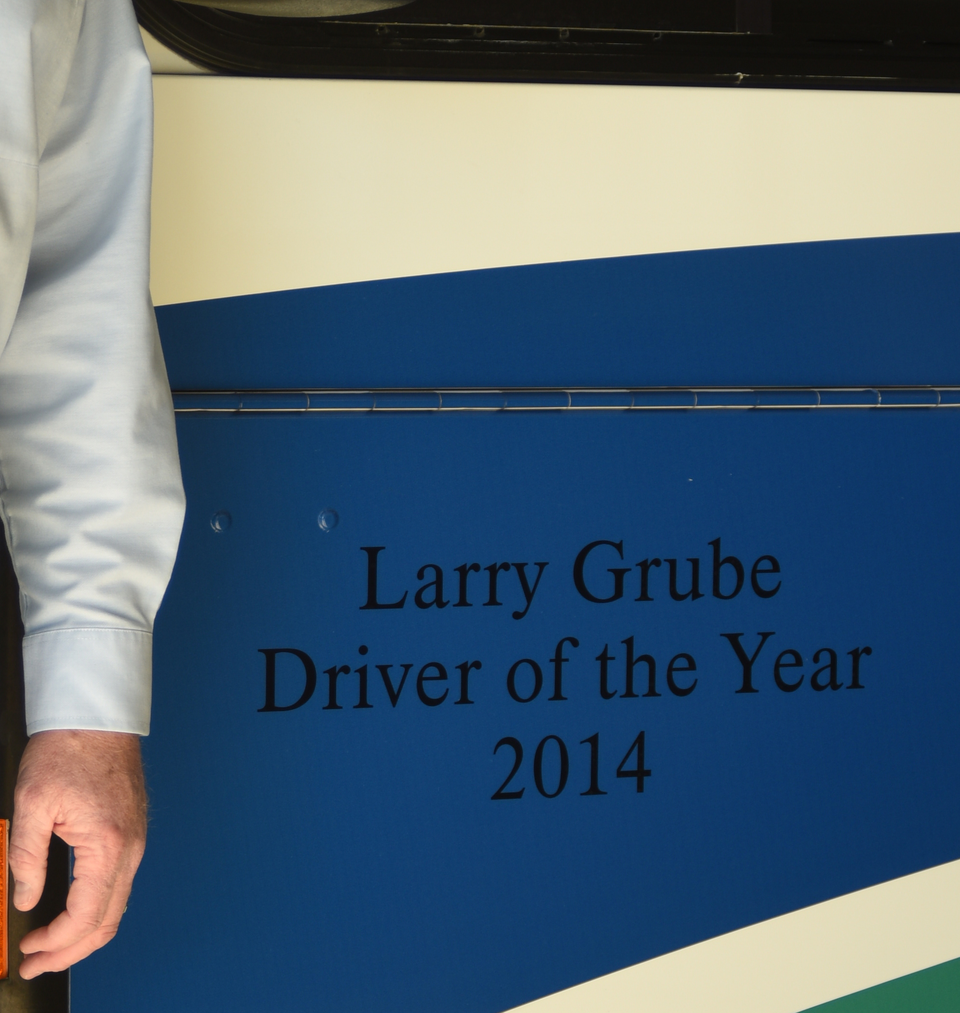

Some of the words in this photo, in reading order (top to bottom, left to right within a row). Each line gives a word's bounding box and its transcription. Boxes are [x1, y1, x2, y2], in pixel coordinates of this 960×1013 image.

[359, 546, 549, 620] Larry
[572, 537, 782, 604] Grube
[257, 644, 482, 713] Driver
[506, 636, 580, 704] of
[595, 635, 698, 700] the
[719, 631, 872, 694] Year
[490, 730, 652, 801] 2014
